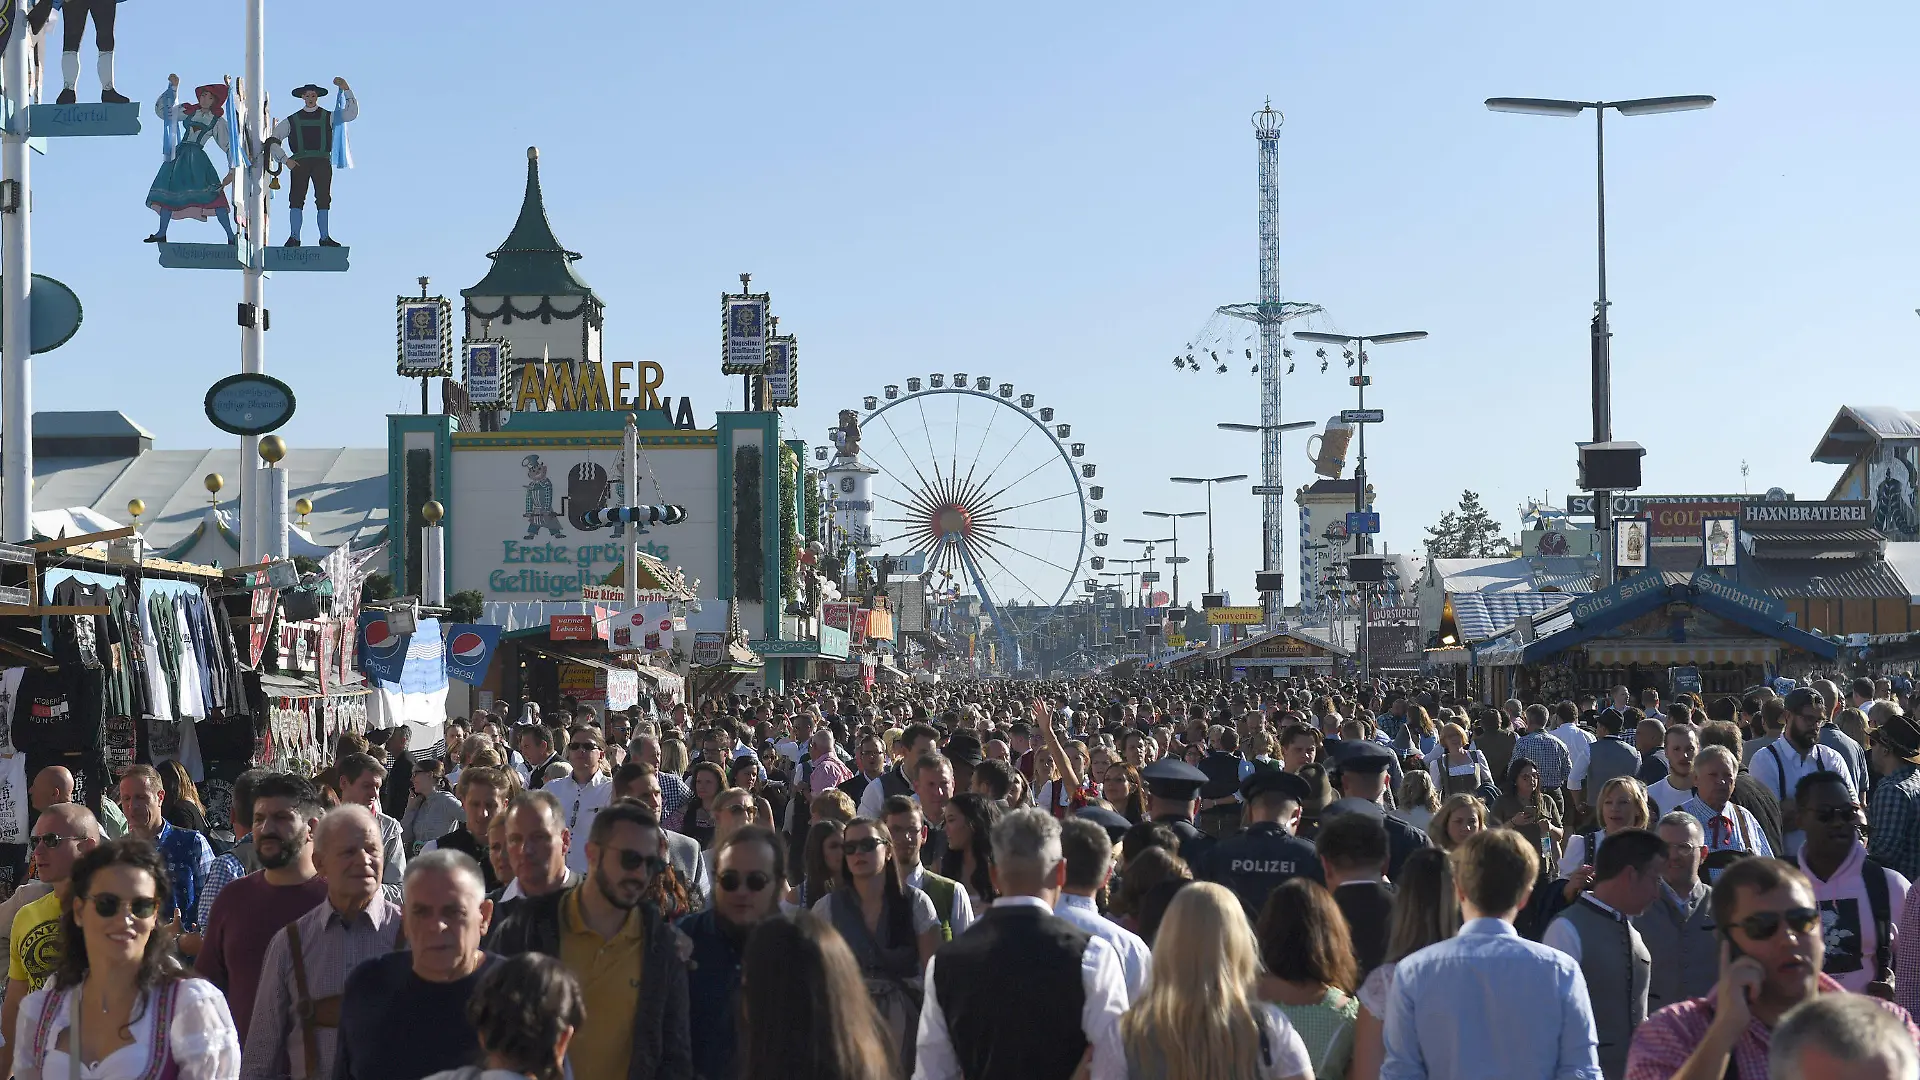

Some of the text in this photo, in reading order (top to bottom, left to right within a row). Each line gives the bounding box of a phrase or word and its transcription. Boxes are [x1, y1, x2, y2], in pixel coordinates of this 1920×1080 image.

[515, 361, 664, 411] AMMER
[1746, 506, 1867, 521] HAXNBRATEREI
[583, 587, 599, 600] Die
[601, 588, 624, 601] klein
[1619, 575, 1660, 600] Stein
[1696, 573, 1773, 615] Souvenir
[1212, 611, 1257, 620] Souvenirs
[1231, 860, 1296, 873] POLIZEI
